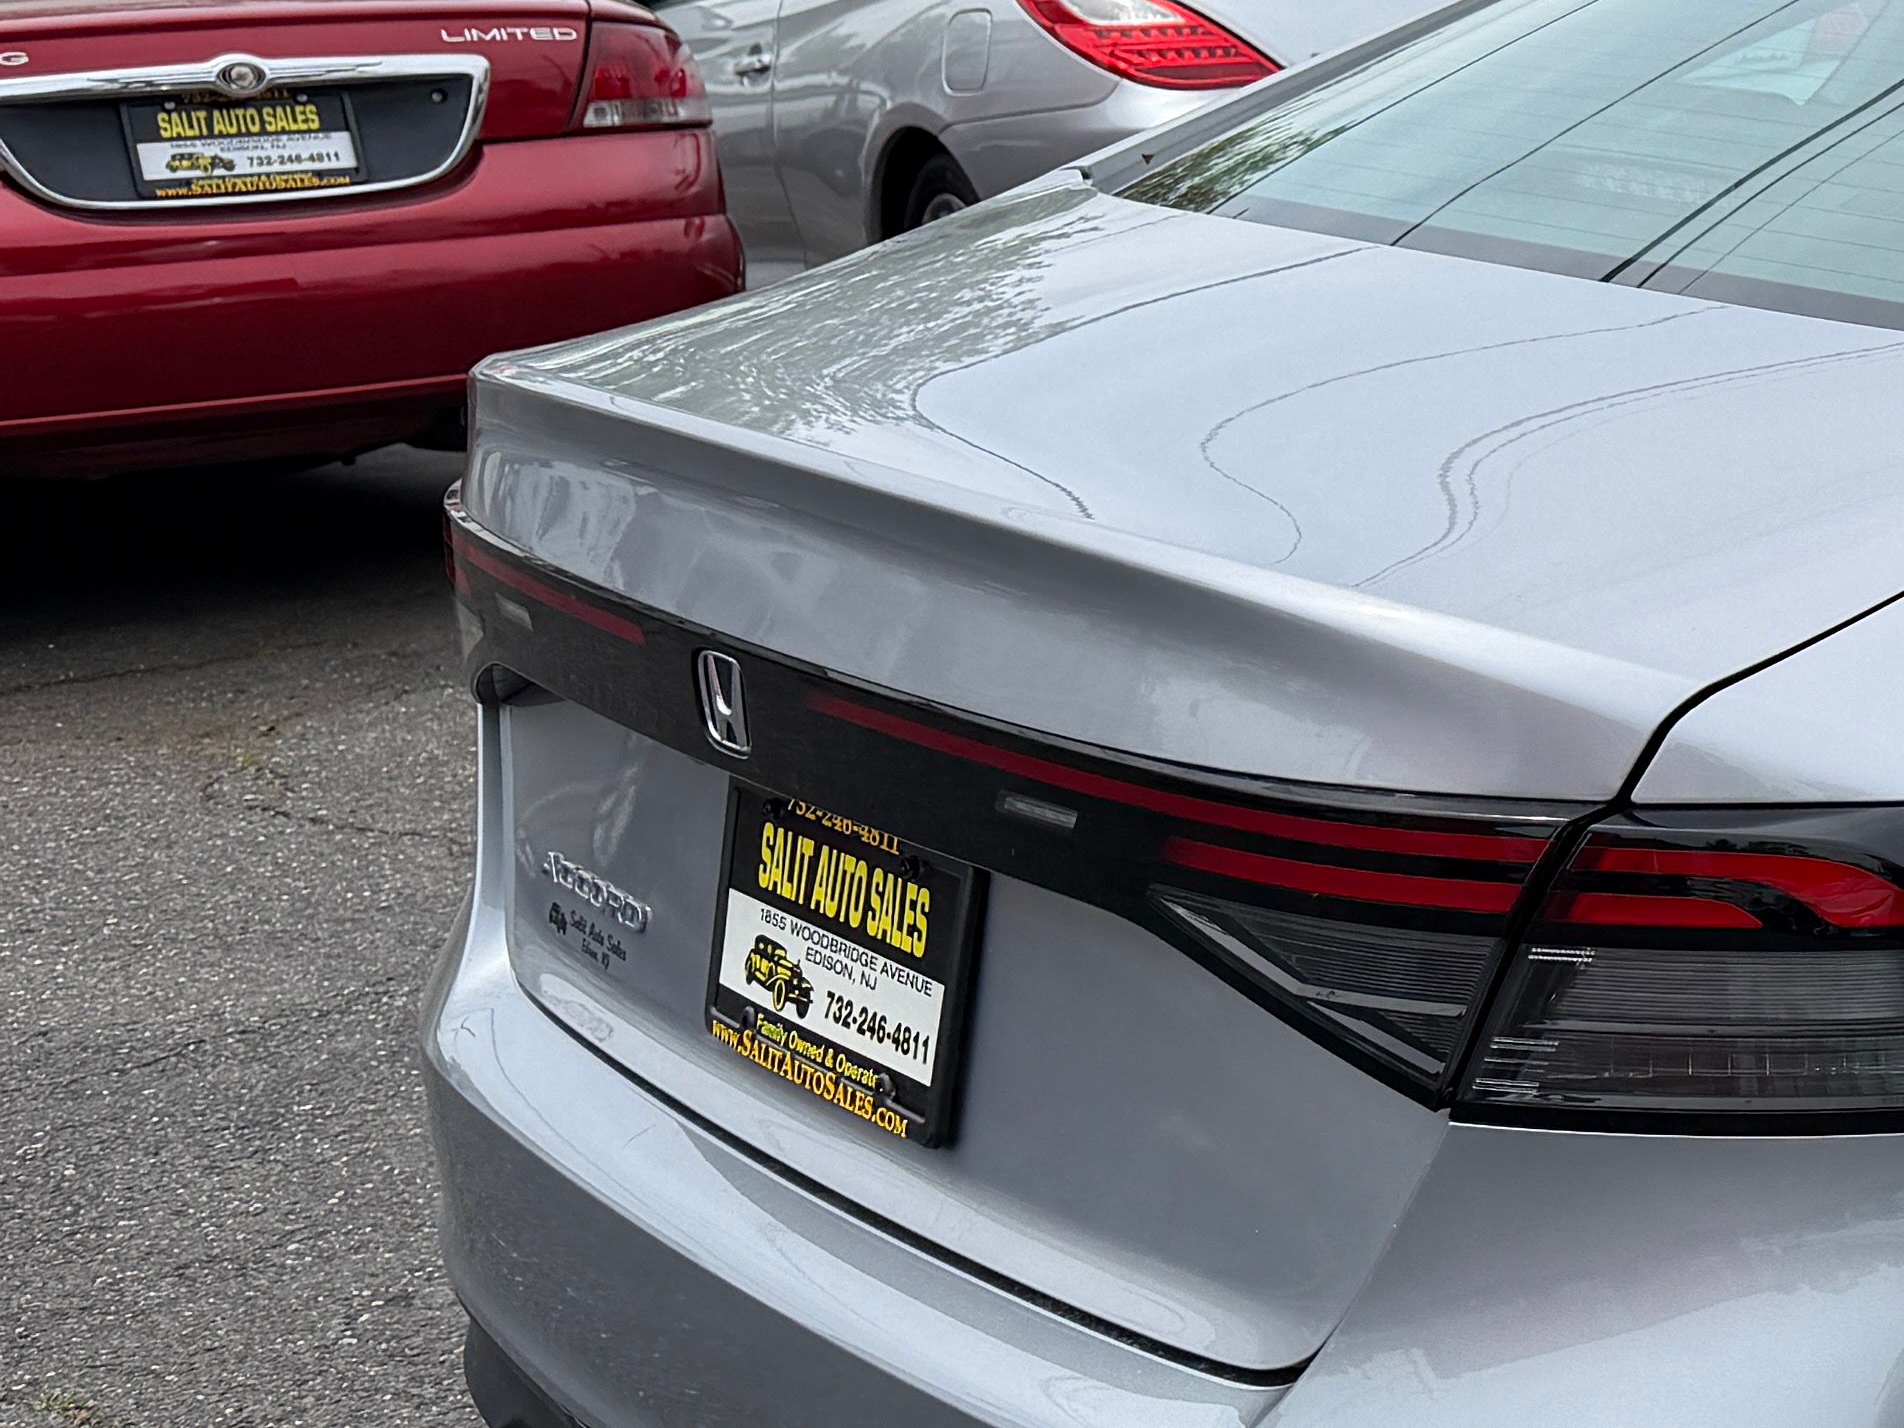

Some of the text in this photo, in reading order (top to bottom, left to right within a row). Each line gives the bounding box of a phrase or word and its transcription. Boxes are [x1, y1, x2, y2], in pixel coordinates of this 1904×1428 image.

[440, 27, 578, 42] LIMITED
[158, 104, 320, 138] SALIT AUTO SALES
[247, 150, 341, 168] 732-246-4811
[758, 821, 931, 959] SALIT AUTO SALES
[760, 908, 933, 998] 1855 WOODBRIDGE AVENUE
[805, 947, 878, 992] EDISON, NJ
[756, 1012, 788, 1048] Family
[788, 1032, 824, 1064] Owned
[825, 1048, 834, 1068] &
[824, 989, 931, 1066] 732-246-4811
